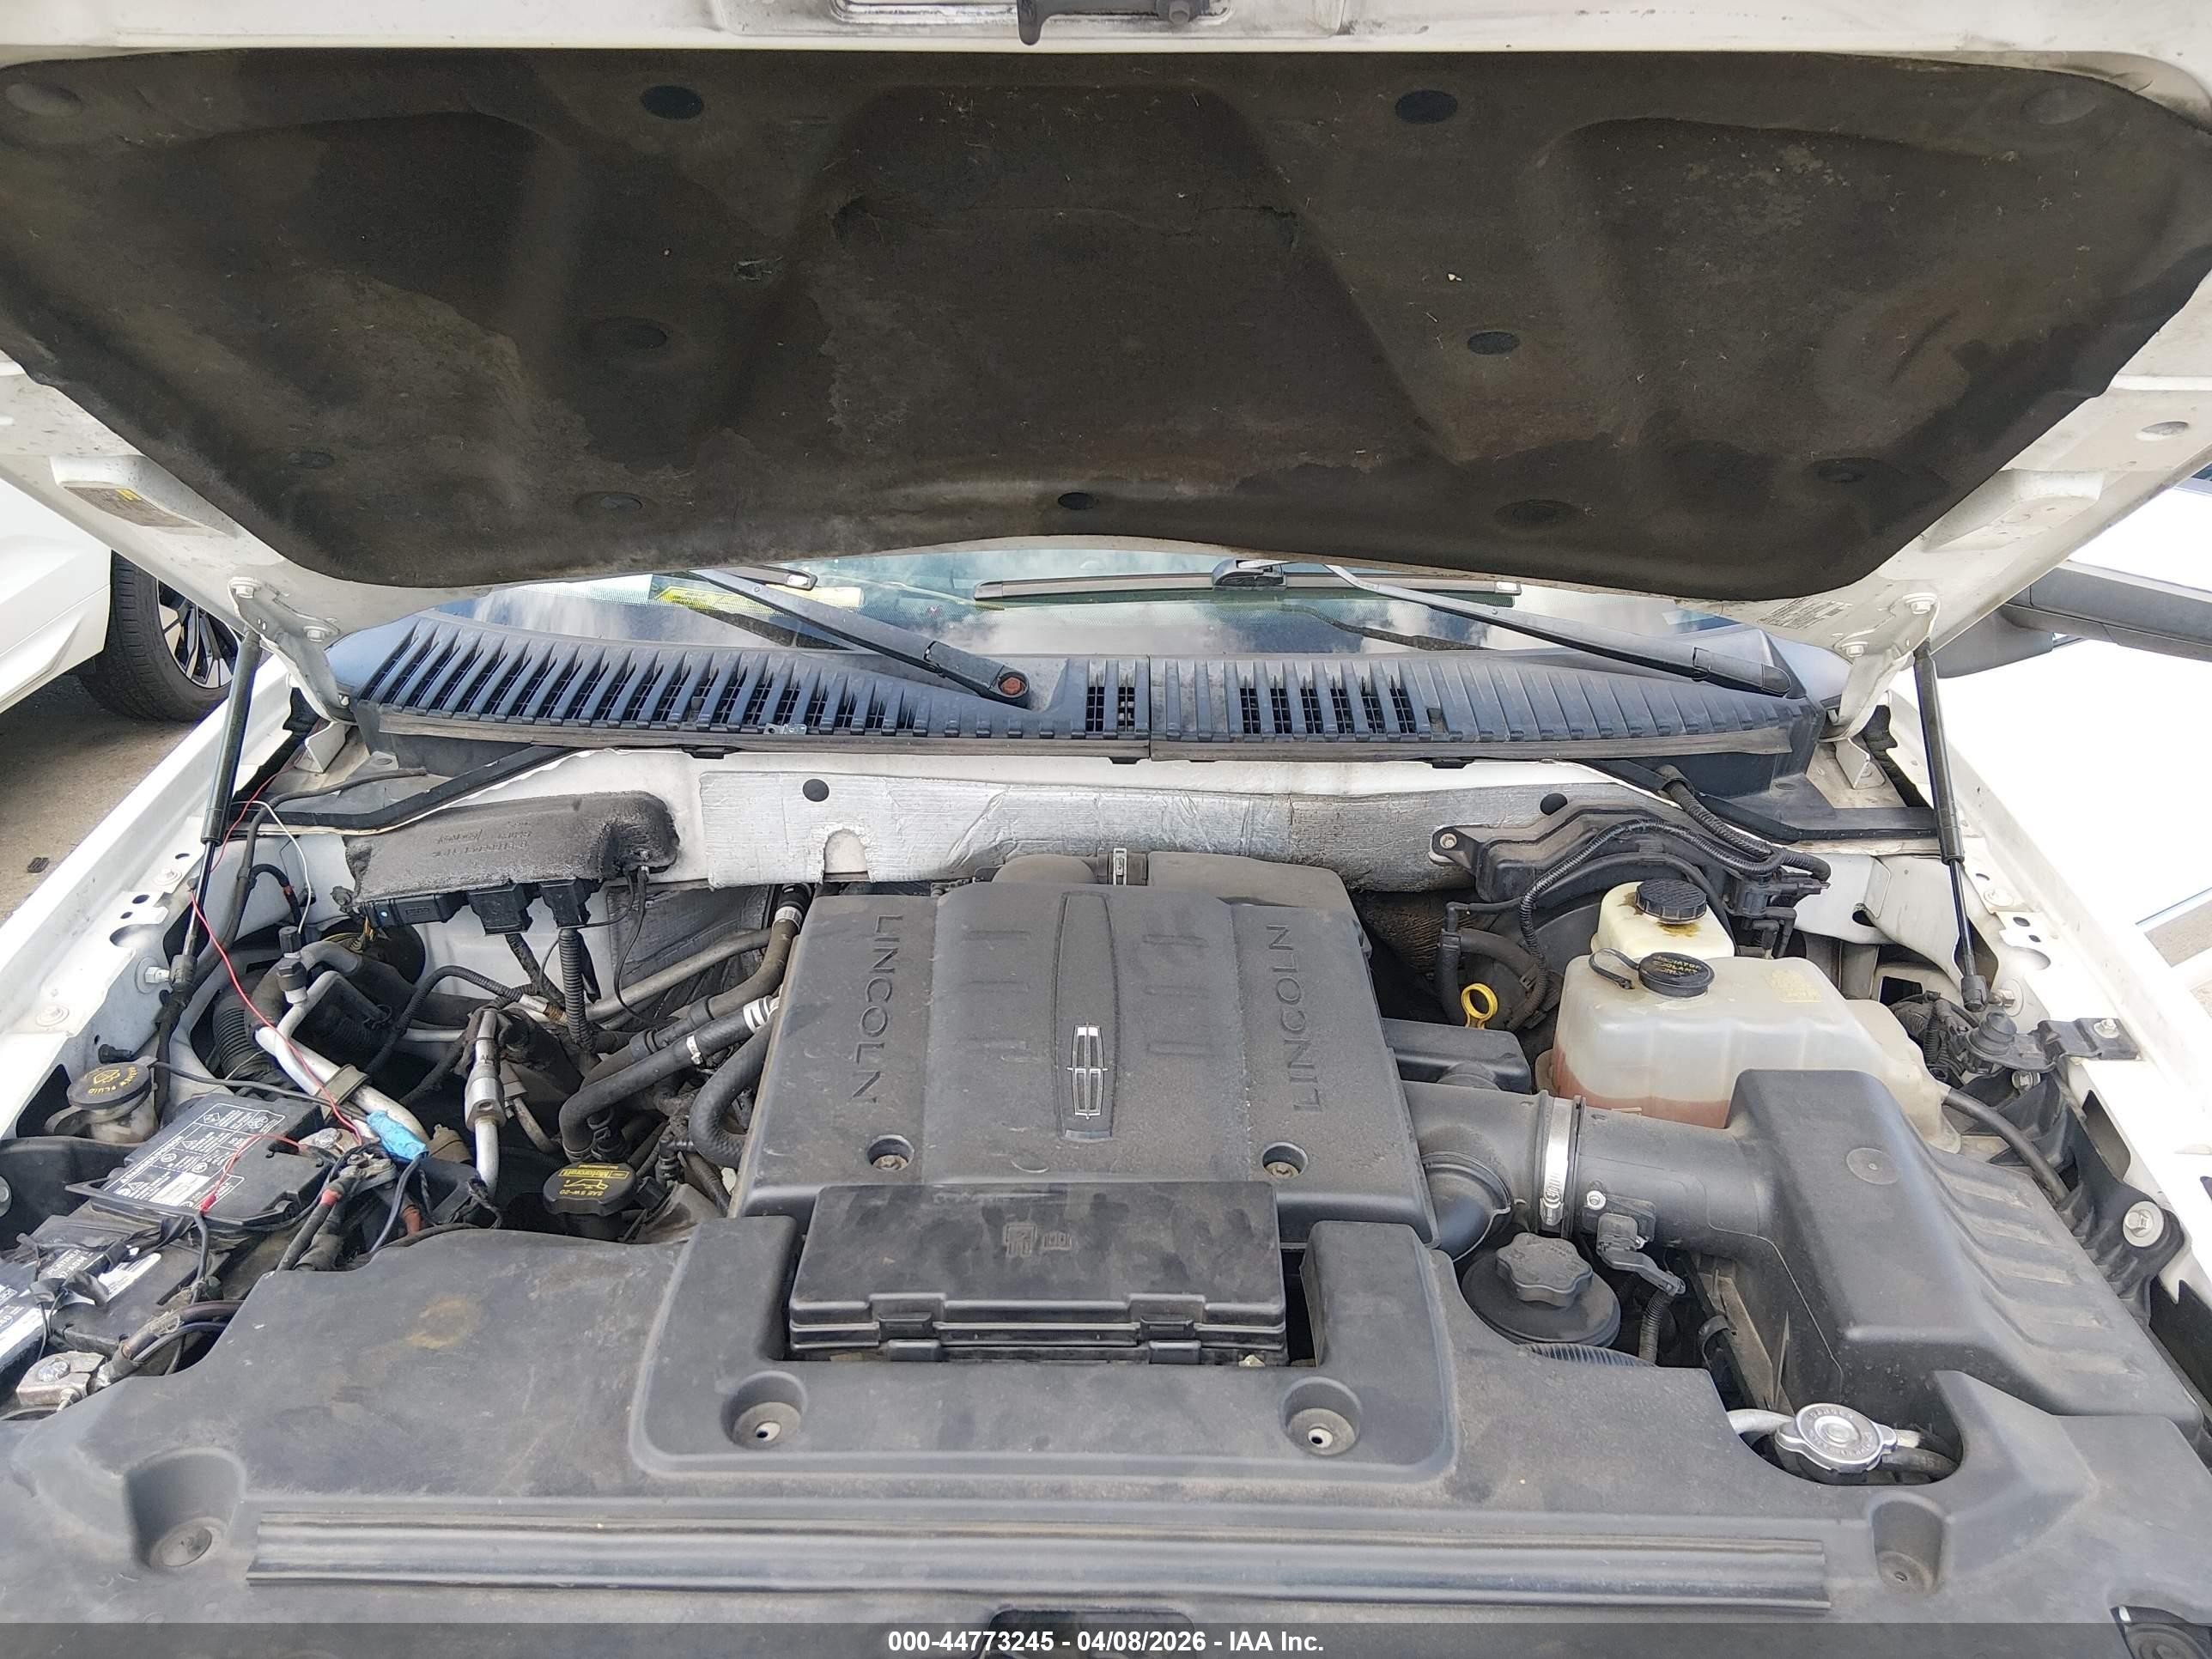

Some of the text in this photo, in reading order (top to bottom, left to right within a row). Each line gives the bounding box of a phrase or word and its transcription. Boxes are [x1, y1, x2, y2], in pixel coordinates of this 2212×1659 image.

[852, 915, 902, 1104] LINCOLN
[1267, 924, 1322, 1112] LINCOLN
[562, 1170, 610, 1178] Motorcraft
